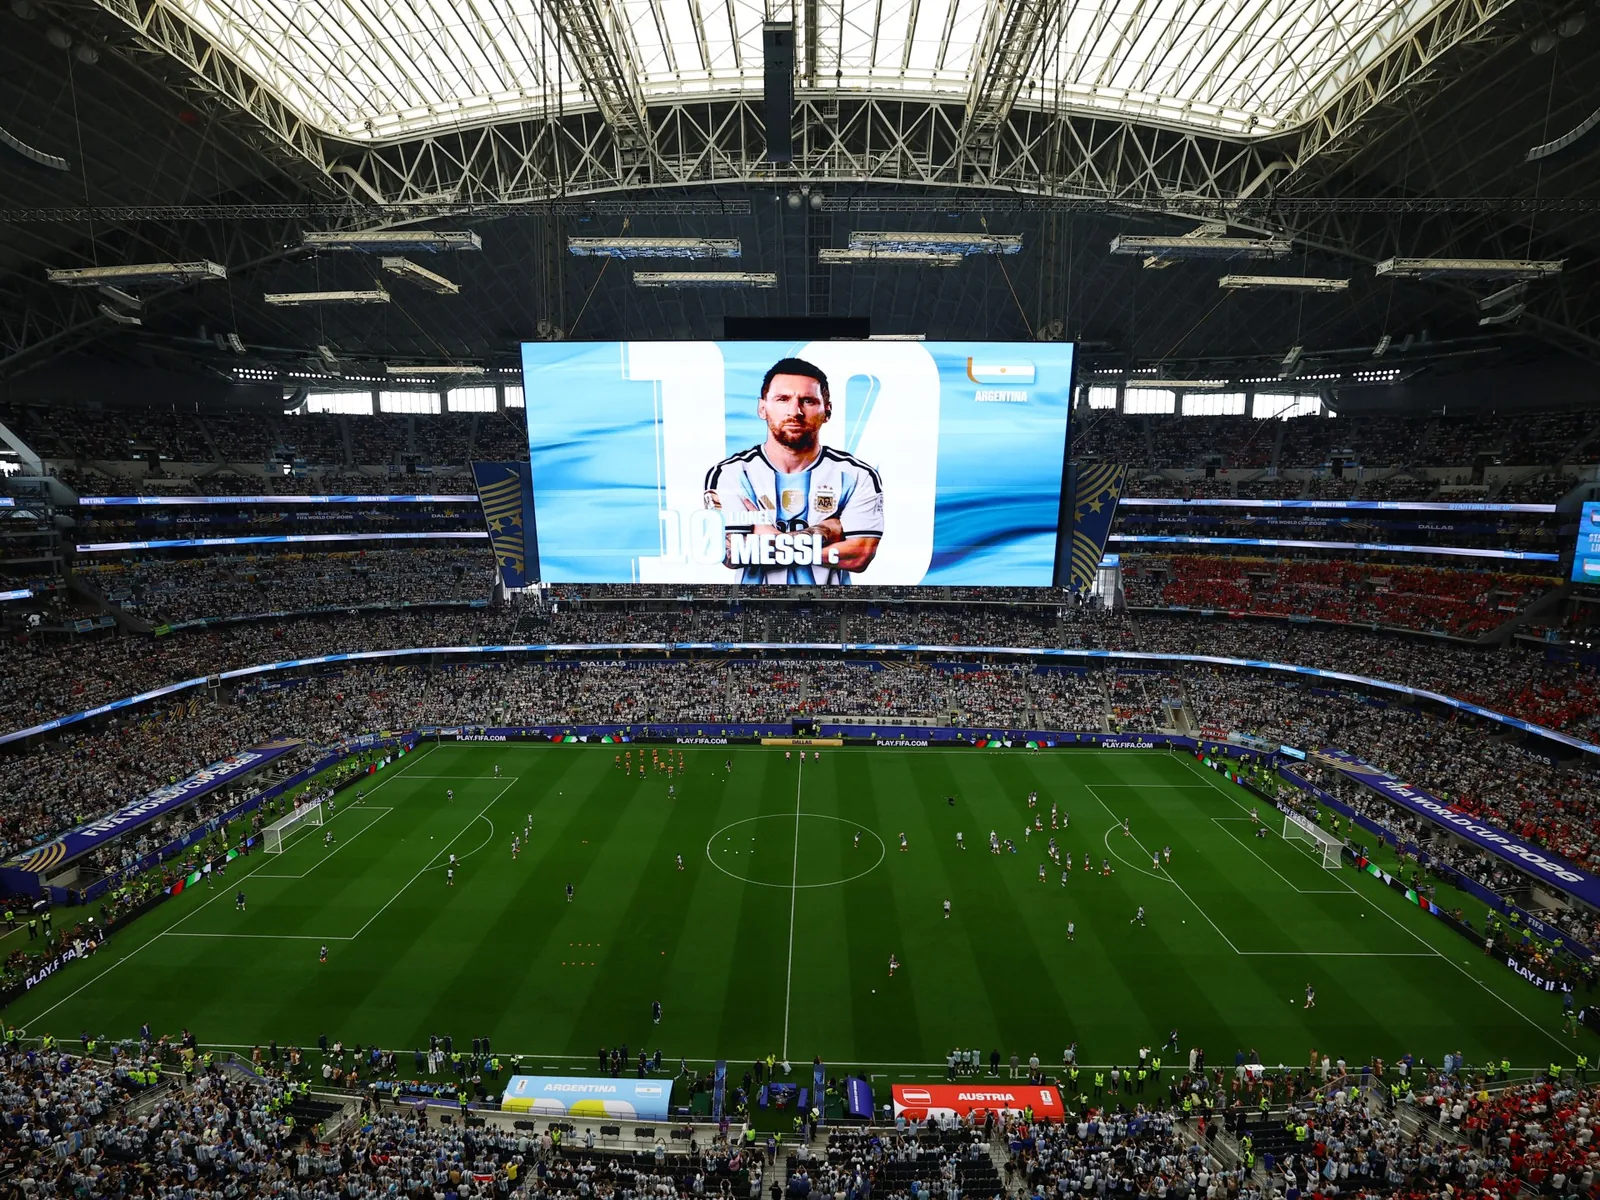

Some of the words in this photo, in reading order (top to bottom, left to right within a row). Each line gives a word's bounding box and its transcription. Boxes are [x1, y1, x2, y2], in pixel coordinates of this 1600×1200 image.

[974, 390, 1028, 402] ARGENTINA
[730, 511, 770, 525] LIONEL
[659, 509, 726, 566] 10
[1588, 533, 1600, 542] STA
[730, 534, 822, 565] MESSI
[80, 817, 132, 837] FIFA
[1378, 780, 1415, 798] FIFA
[1409, 796, 1473, 826] WORLD
[1465, 825, 1510, 844] CUP
[1501, 844, 1585, 882] 2026
[1527, 916, 1544, 932] FIFA
[544, 1083, 616, 1093] ARGENTINA
[958, 1092, 1015, 1101] AUSTRIA
